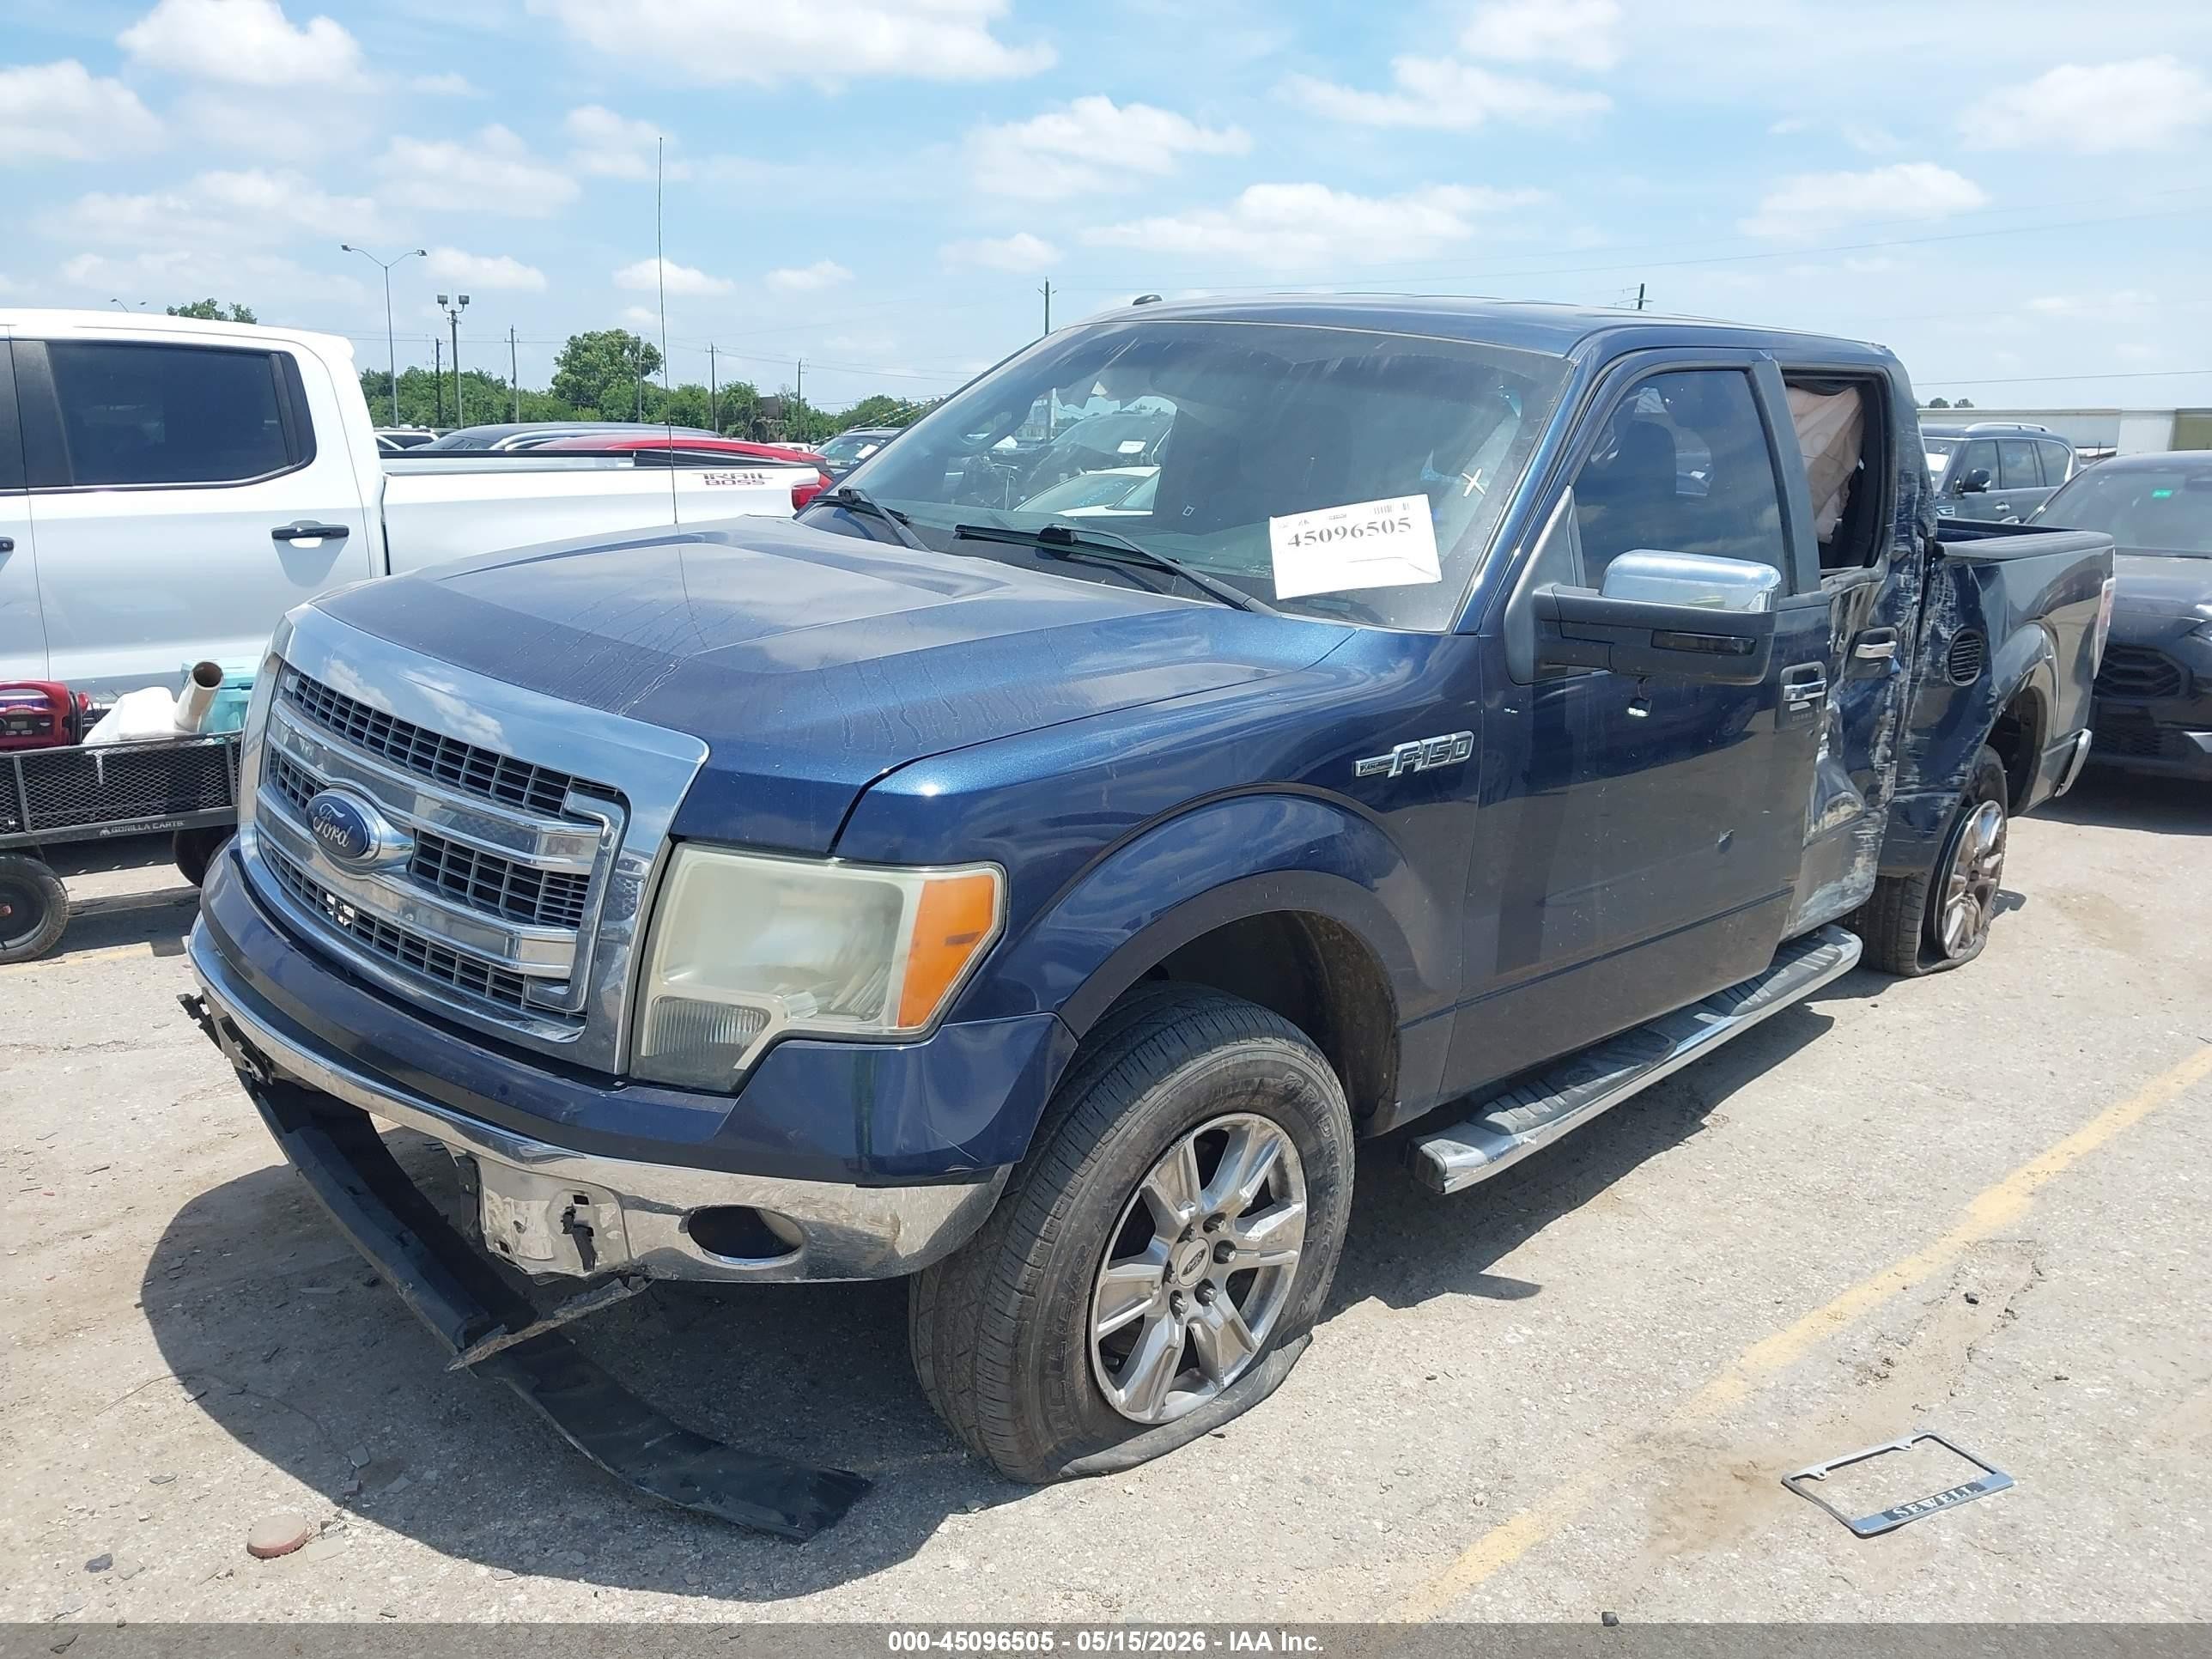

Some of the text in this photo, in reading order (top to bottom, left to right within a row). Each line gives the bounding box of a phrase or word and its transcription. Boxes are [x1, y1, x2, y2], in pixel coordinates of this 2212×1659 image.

[1287, 517, 1412, 547] 45096505
[112, 823, 151, 834] GORILLA
[313, 803, 354, 848] Ford
[1892, 1486, 1978, 1518] SEWELL
